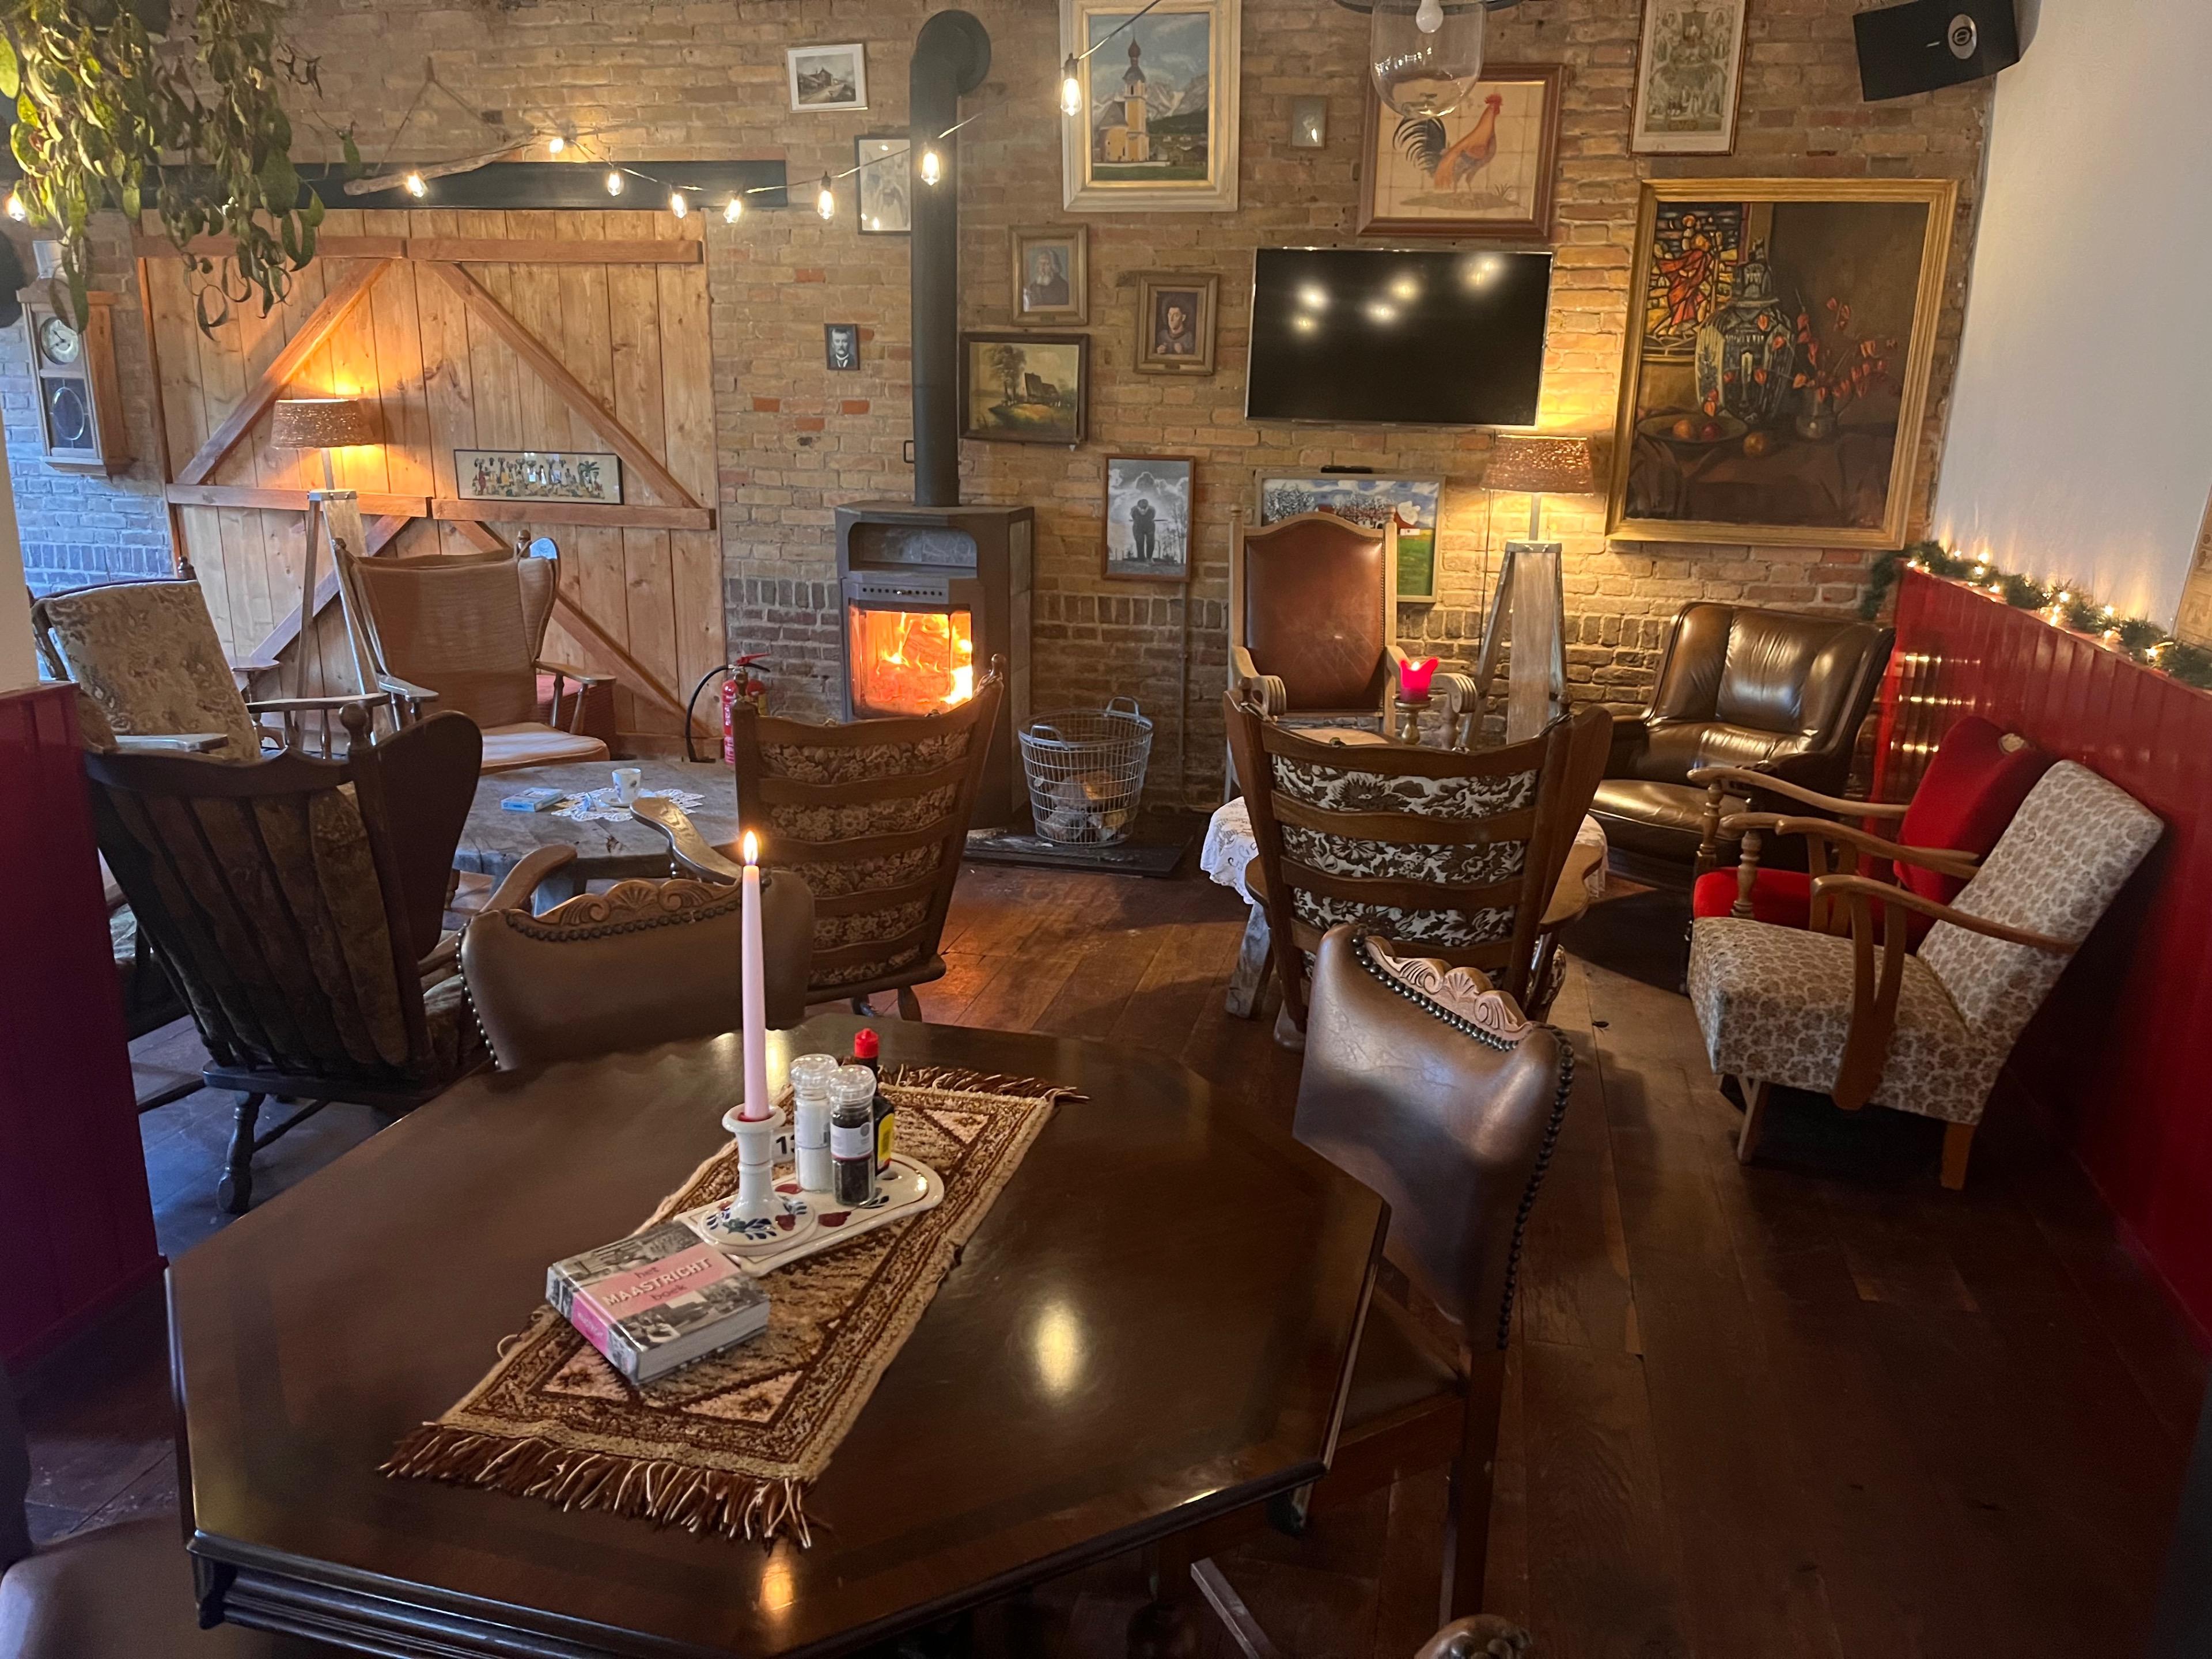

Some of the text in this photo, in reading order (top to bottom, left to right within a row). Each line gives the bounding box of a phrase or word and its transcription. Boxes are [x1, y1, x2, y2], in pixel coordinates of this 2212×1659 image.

[634, 1266, 660, 1279] het
[601, 1258, 713, 1306] MAASTRICHT
[649, 1283, 688, 1301] boek
